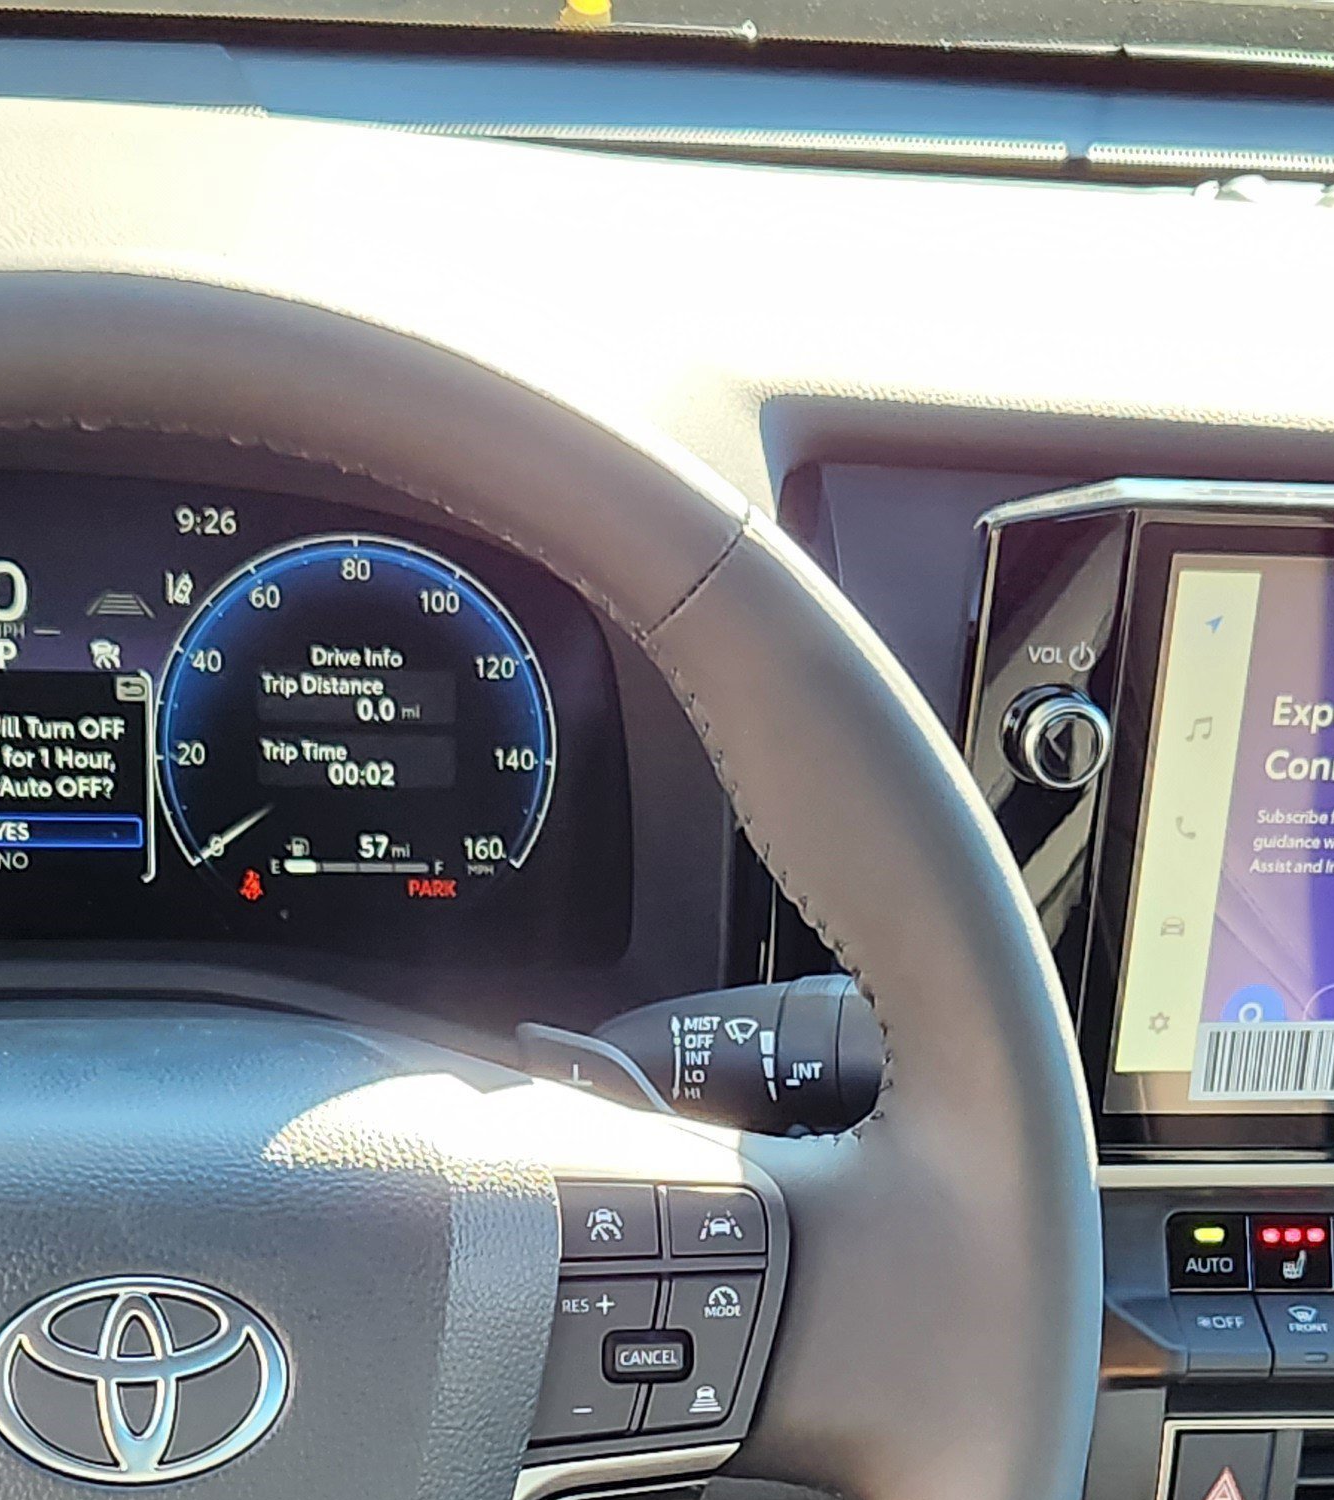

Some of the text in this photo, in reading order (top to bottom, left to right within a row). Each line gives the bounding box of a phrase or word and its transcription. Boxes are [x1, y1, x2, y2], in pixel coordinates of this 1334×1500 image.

[176, 509, 237, 535] 9:26
[342, 559, 371, 581] 80
[250, 587, 280, 609] 60
[420, 591, 460, 614] 100
[192, 651, 222, 672] 40
[311, 646, 403, 668] Drive Info
[1028, 646, 1063, 664] VOL
[476, 657, 515, 678] 120
[262, 675, 383, 699] Trip Distance
[357, 700, 420, 721] 0.0 mi
[26, 715, 75, 739] Turn
[79, 717, 125, 739] OFF
[2, 747, 36, 768] for
[40, 747, 50, 768] 1
[177, 742, 205, 765] 20
[262, 740, 347, 762] Trip Time
[495, 749, 533, 770] 140
[328, 764, 395, 786] 00:02
[0, 775, 52, 798] Auto
[56, 777, 113, 799] OFF?
[1257, 809, 1328, 826] Subscribe
[358, 836, 410, 859] 57 mi
[465, 838, 503, 860] 160
[1253, 835, 1320, 853] guidance
[270, 859, 280, 875] E
[434, 861, 443, 876] F
[1250, 859, 1292, 874] Assist
[1294, 860, 1322, 874] and
[408, 880, 456, 897] PARK
[684, 1016, 720, 1032] MIST
[684, 1034, 714, 1049] OFF
[685, 1051, 712, 1066] INT
[684, 1069, 705, 1083] LO
[791, 1062, 822, 1080] INT
[1185, 1257, 1233, 1274] AUTO
[562, 1299, 589, 1313] RES
[704, 1305, 741, 1318] MODE
[1212, 1315, 1244, 1329] OFF
[1288, 1322, 1329, 1334] FRONT
[620, 1350, 677, 1366] CANCEL
